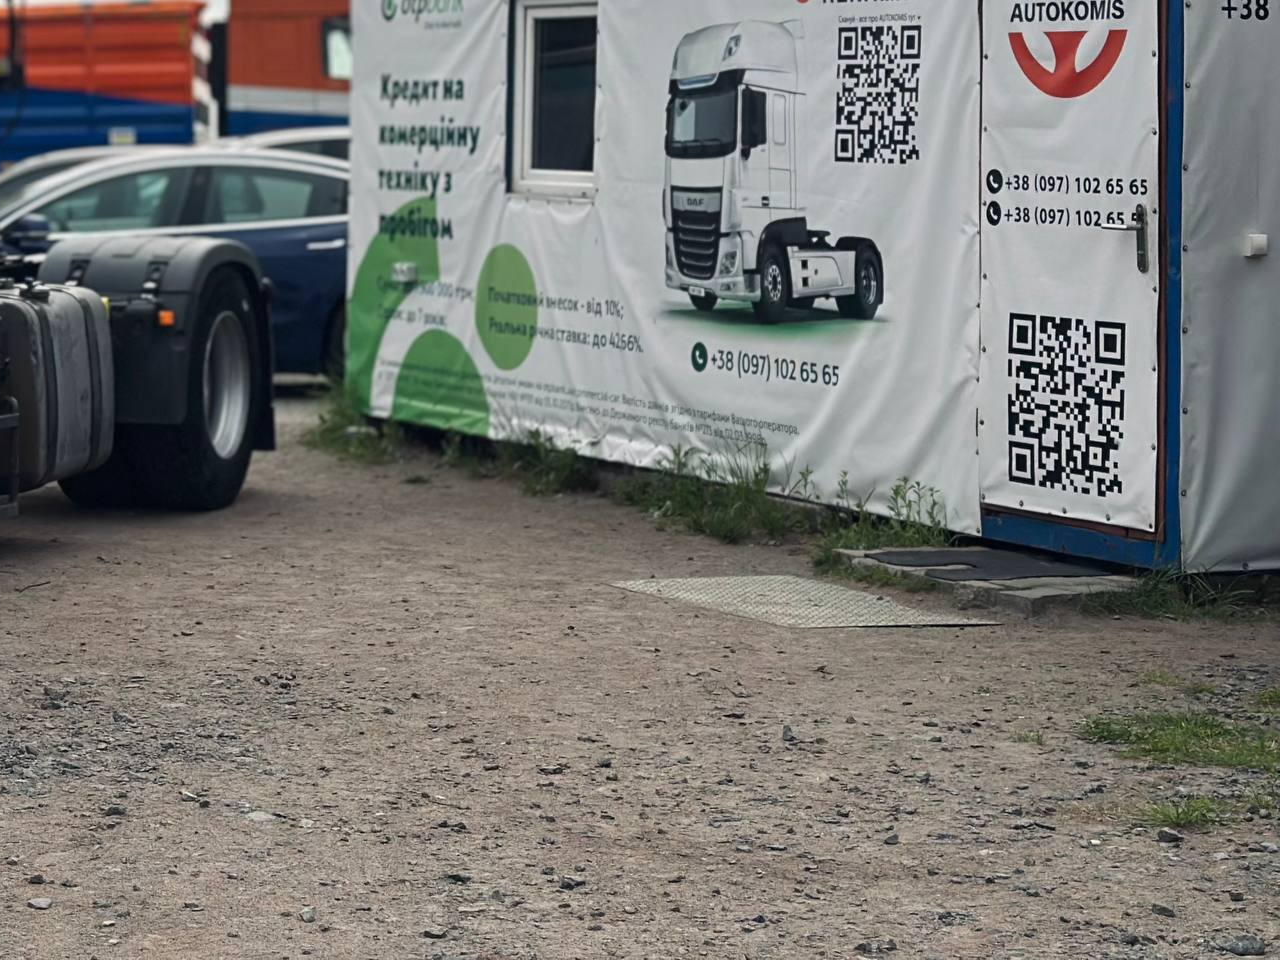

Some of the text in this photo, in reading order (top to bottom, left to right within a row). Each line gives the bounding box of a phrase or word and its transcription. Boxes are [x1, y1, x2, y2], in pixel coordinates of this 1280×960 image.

[1010, 0, 1125, 23] AUTOKOMIS
[380, 74, 464, 108] Кредит на
[379, 115, 480, 155] комерційну
[378, 161, 440, 199] техніку
[1005, 174, 1148, 195] +38 (097) 102 65 65
[379, 207, 453, 242] пробігом
[1004, 207, 1030, 223] +38
[1035, 206, 1070, 227] (097)
[1075, 210, 1101, 227] 102
[546, 296, 579, 313] внесок
[586, 297, 603, 317] від
[592, 334, 607, 349] до
[710, 349, 840, 386] +38 (097) 102 65 65
